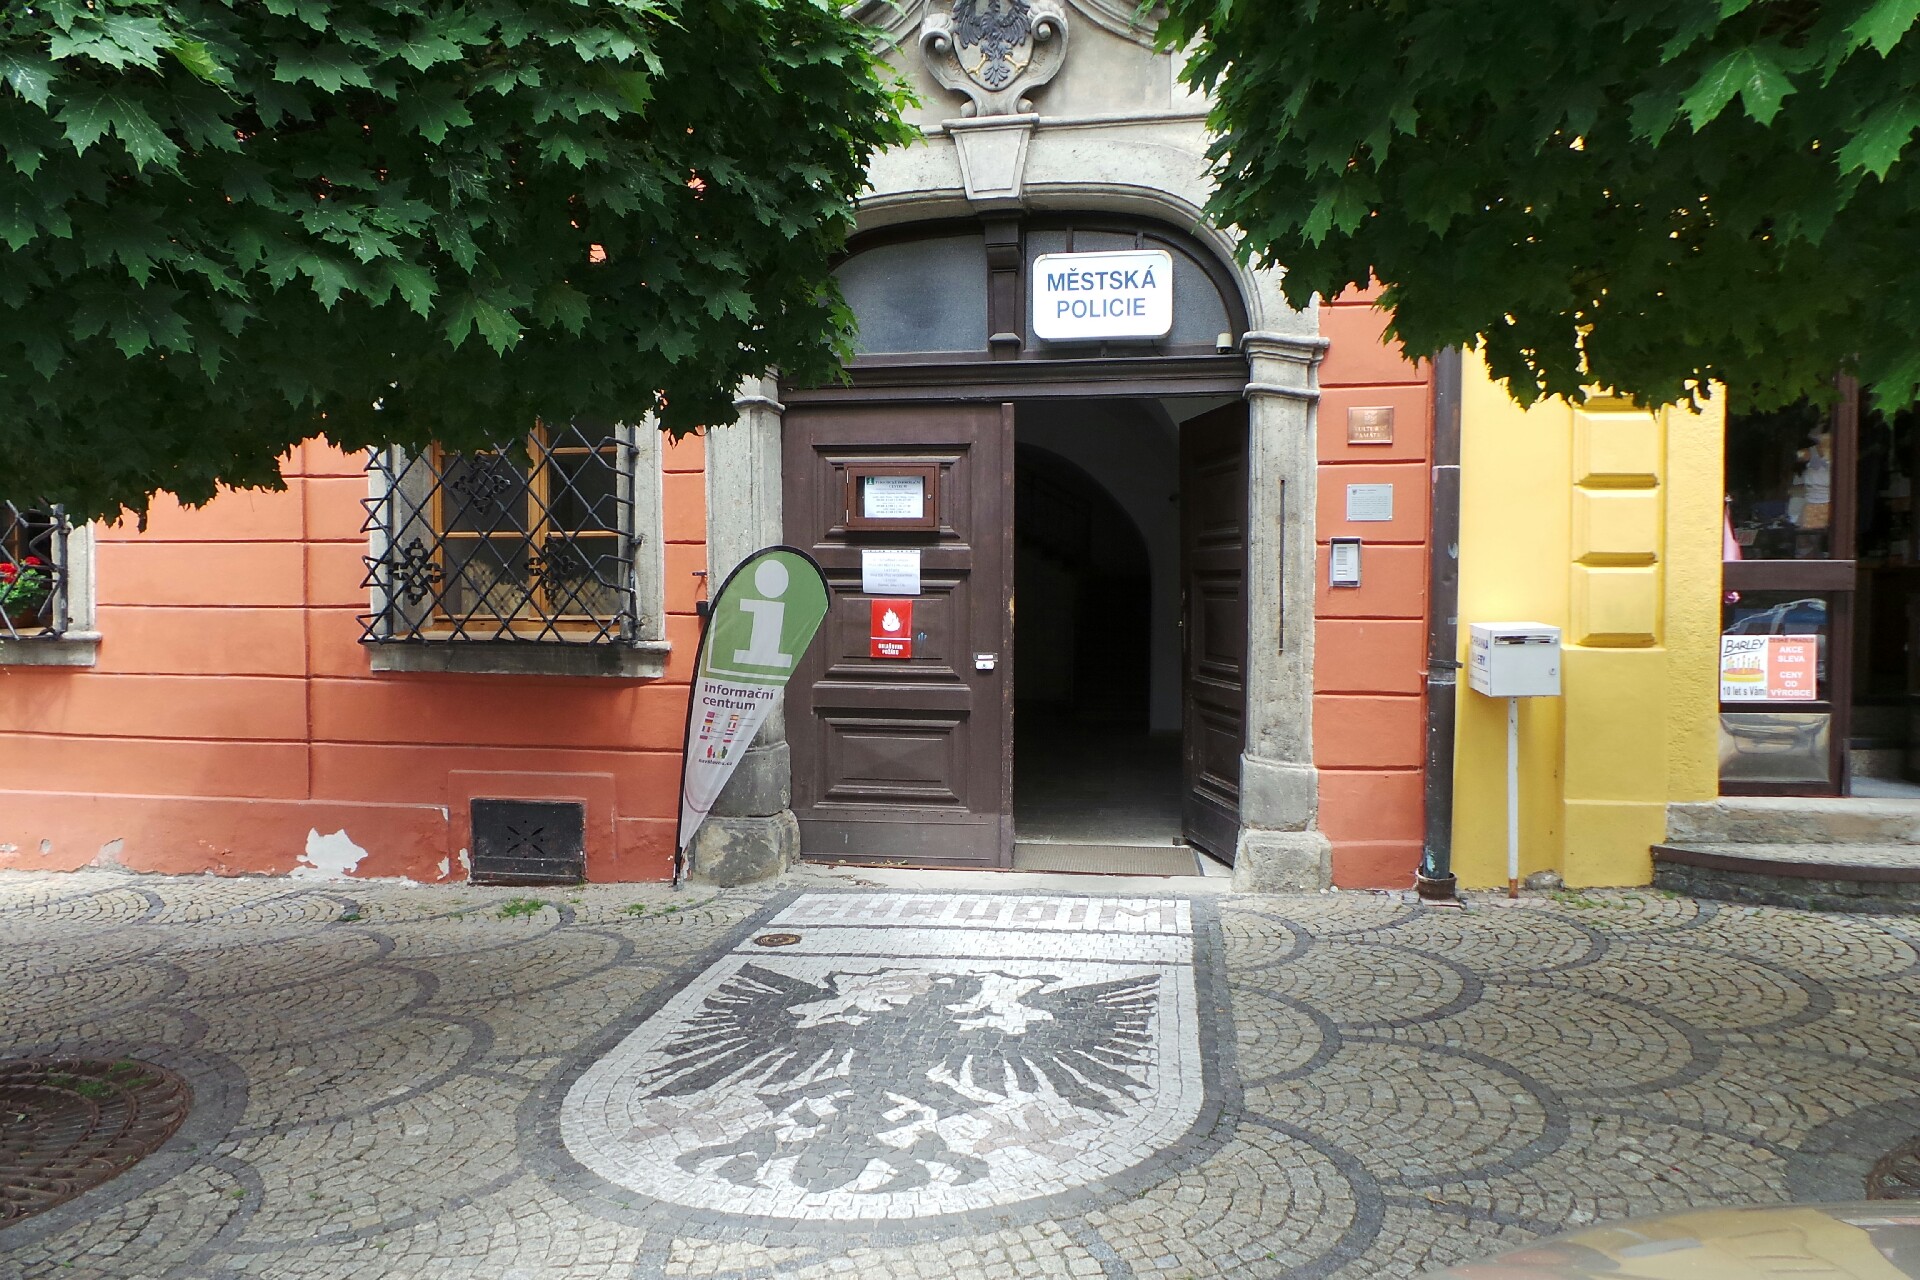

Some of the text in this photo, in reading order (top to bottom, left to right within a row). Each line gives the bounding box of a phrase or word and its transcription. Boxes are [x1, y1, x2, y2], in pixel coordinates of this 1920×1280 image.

[1047, 264, 1156, 292] MĚSTSKÁ
[1057, 297, 1146, 319] POLICIE
[1724, 638, 1765, 654] BARLEY
[1777, 655, 1805, 663] SLEVA
[1779, 671, 1803, 679] CENY
[704, 682, 775, 700] informační
[1723, 686, 1730, 695] 10
[1732, 686, 1742, 695] let
[702, 696, 756, 711] centrum
